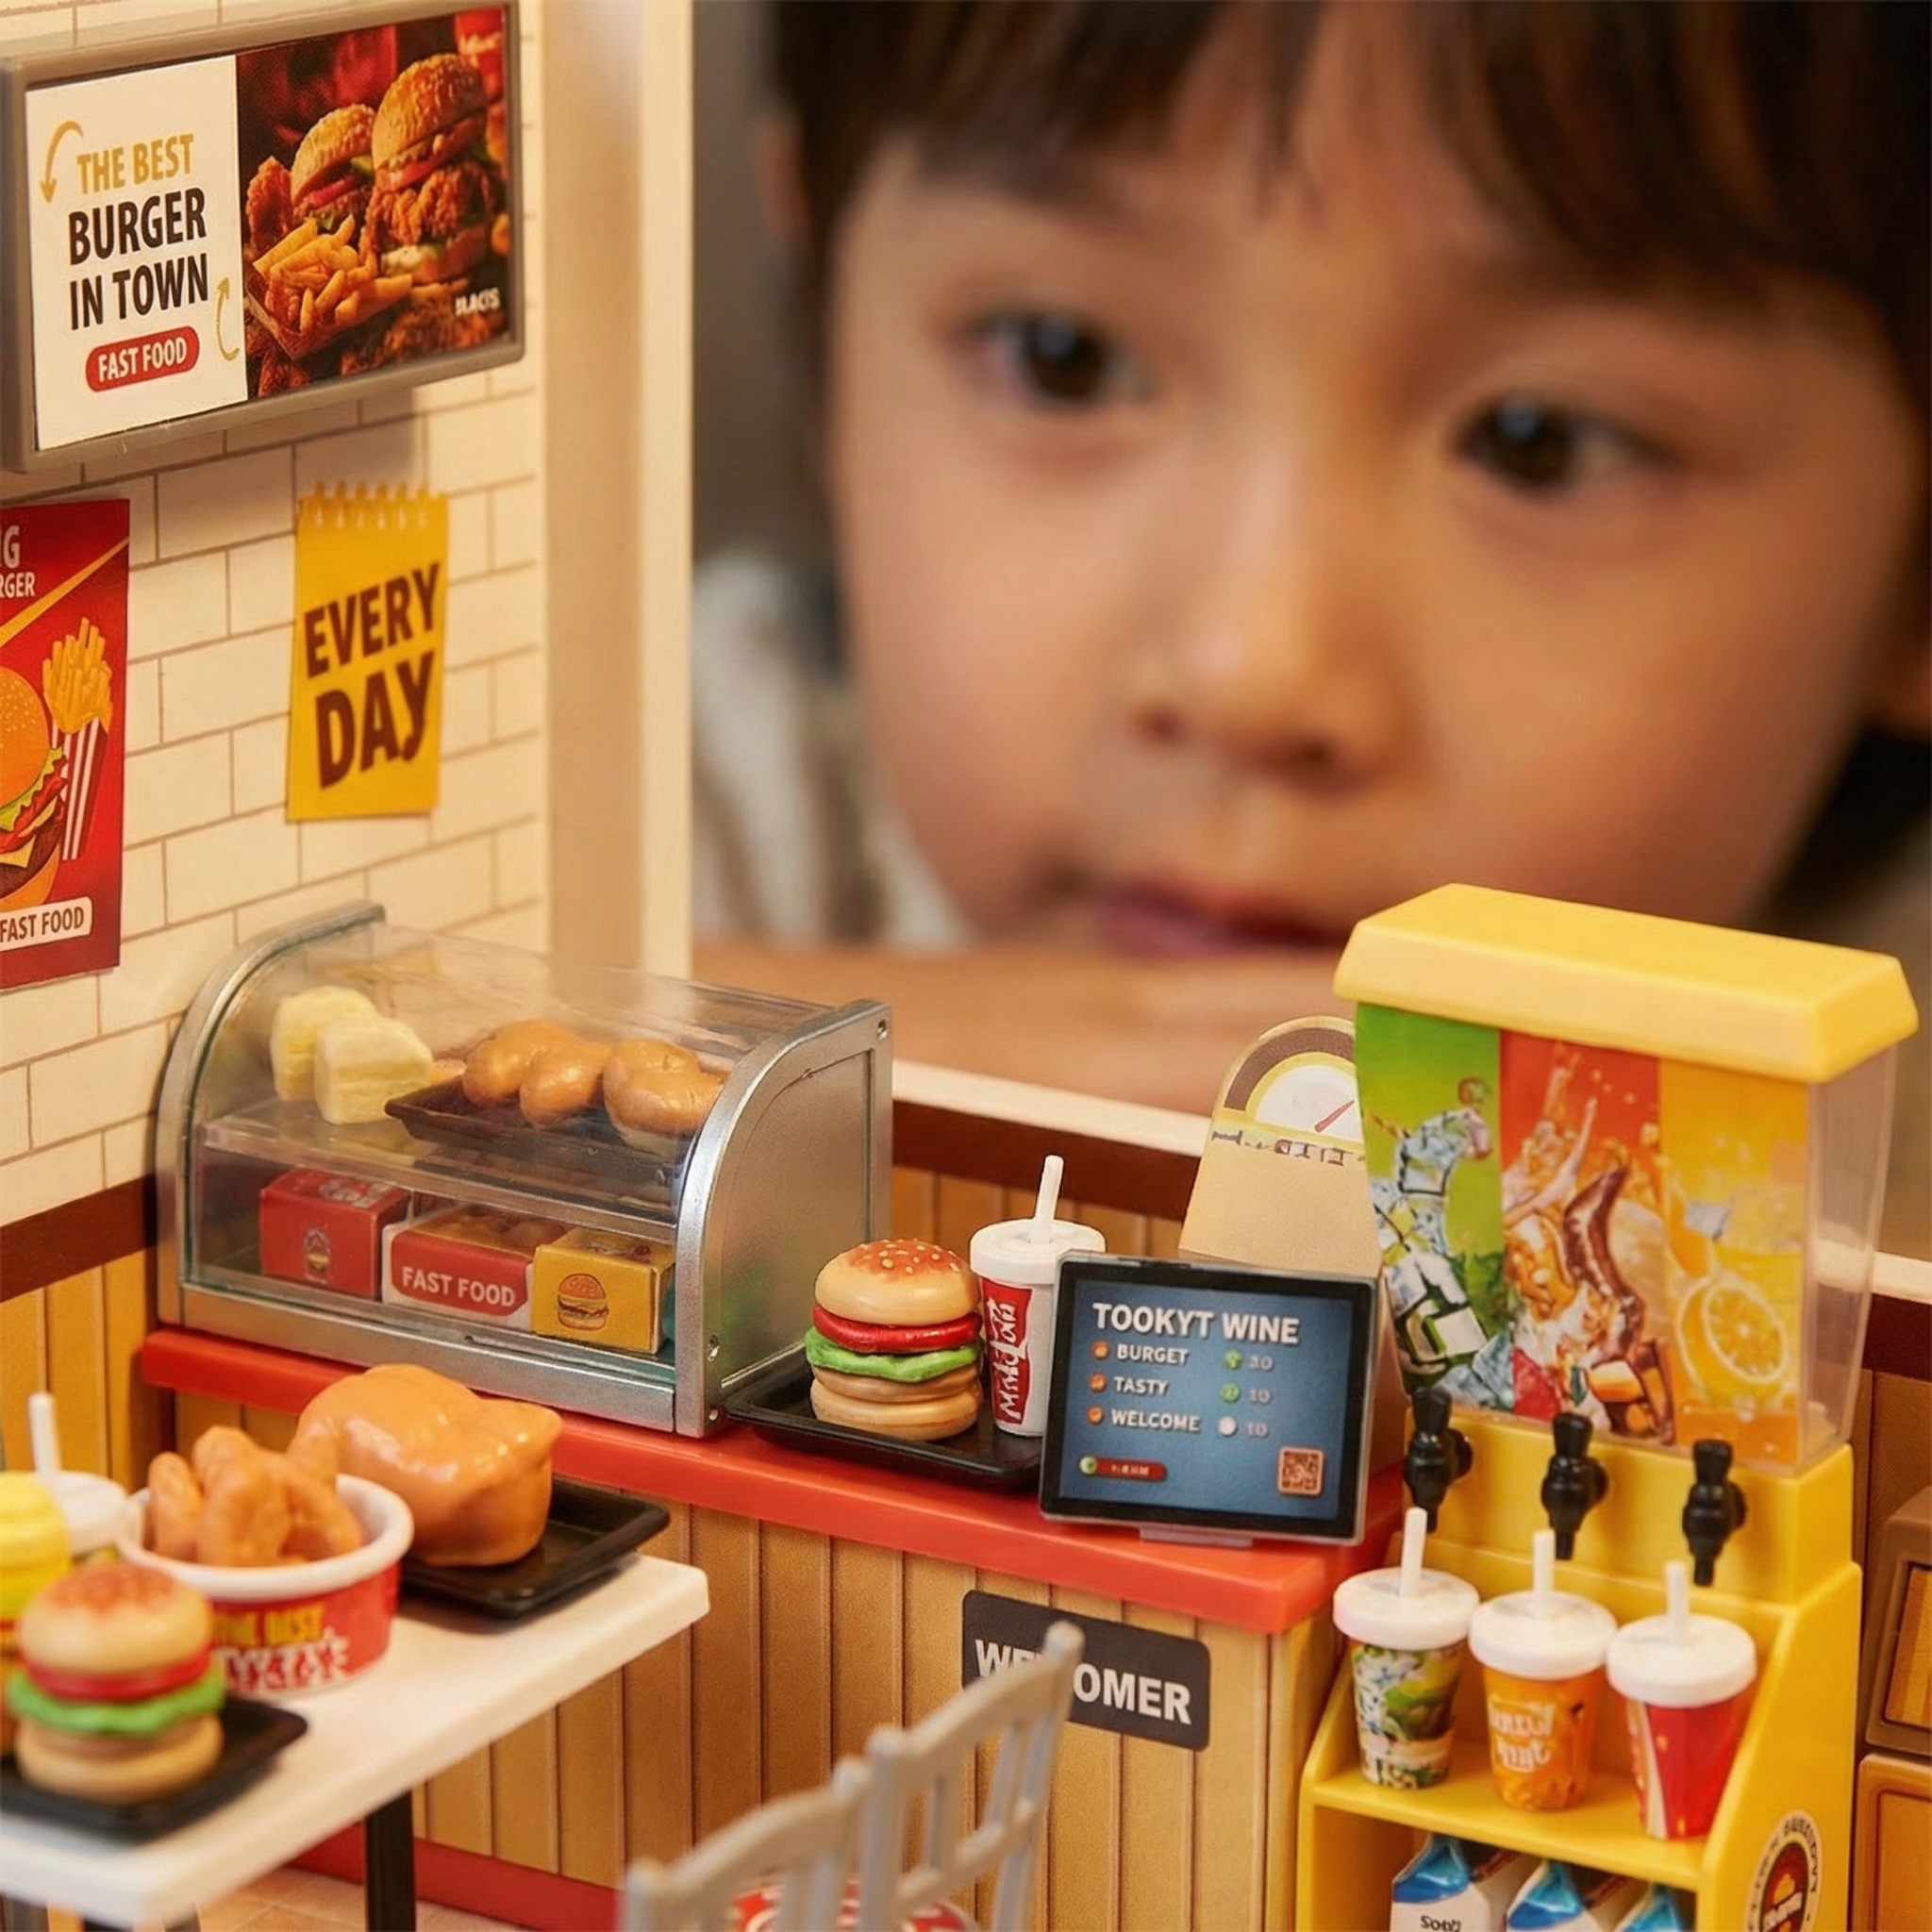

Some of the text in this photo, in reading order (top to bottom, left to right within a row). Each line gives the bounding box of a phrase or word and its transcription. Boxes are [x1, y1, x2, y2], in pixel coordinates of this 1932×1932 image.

[77, 134, 194, 194] THE BEST
[69, 188, 207, 265] BURGER
[71, 253, 208, 330] IN TOWN
[98, 336, 187, 382] FAST FOOD
[0, 525, 20, 569] G
[303, 561, 441, 678] EVERY
[315, 650, 436, 791] DAY
[0, 907, 84, 942] FAST FOOD
[402, 1265, 515, 1307] FAST FOOD
[1092, 1302, 1300, 1344] TOOKYT WINE
[1117, 1343, 1189, 1365] BURGET
[1114, 1376, 1169, 1396] TASTY
[1111, 1408, 1201, 1433] WELCOME
[974, 1639, 1191, 1725] WOMER
